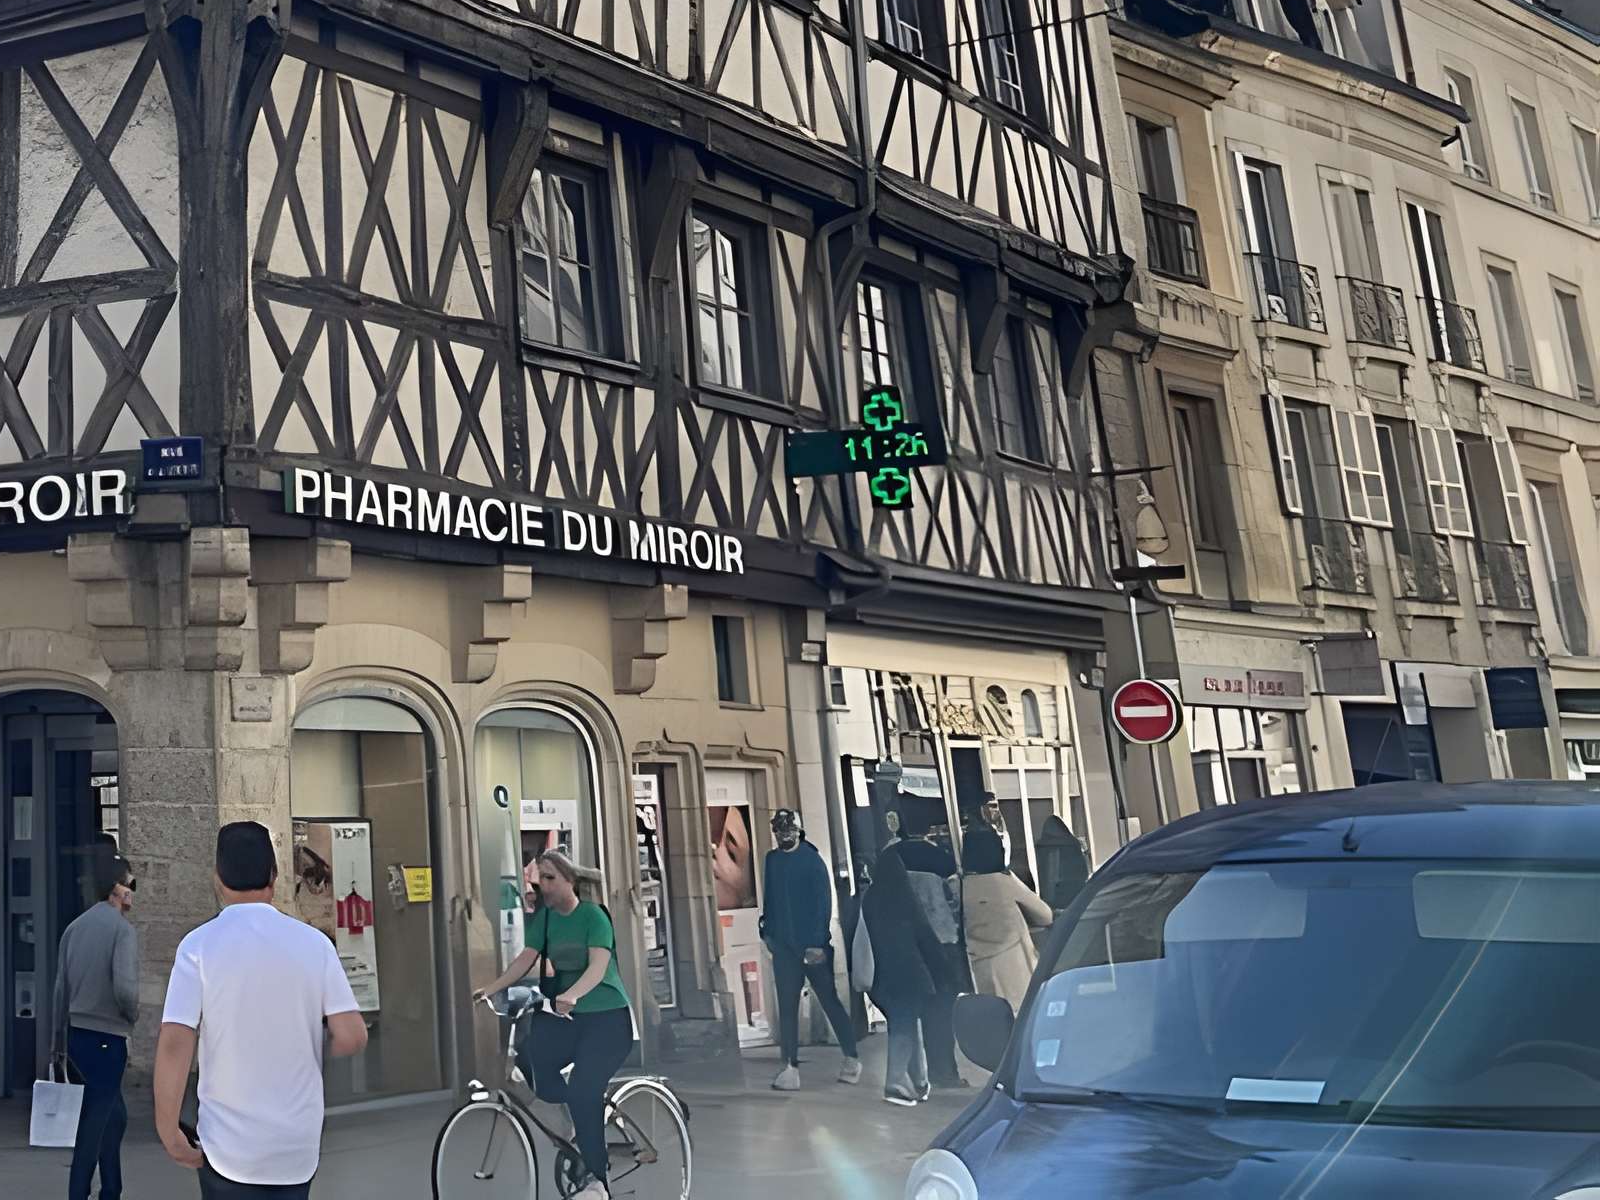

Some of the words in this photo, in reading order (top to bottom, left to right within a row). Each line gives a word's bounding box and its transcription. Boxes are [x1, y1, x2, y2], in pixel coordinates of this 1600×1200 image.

[295, 467, 546, 547] PHARMACIE
[562, 510, 613, 556] DU
[628, 519, 745, 575] MIROIR
